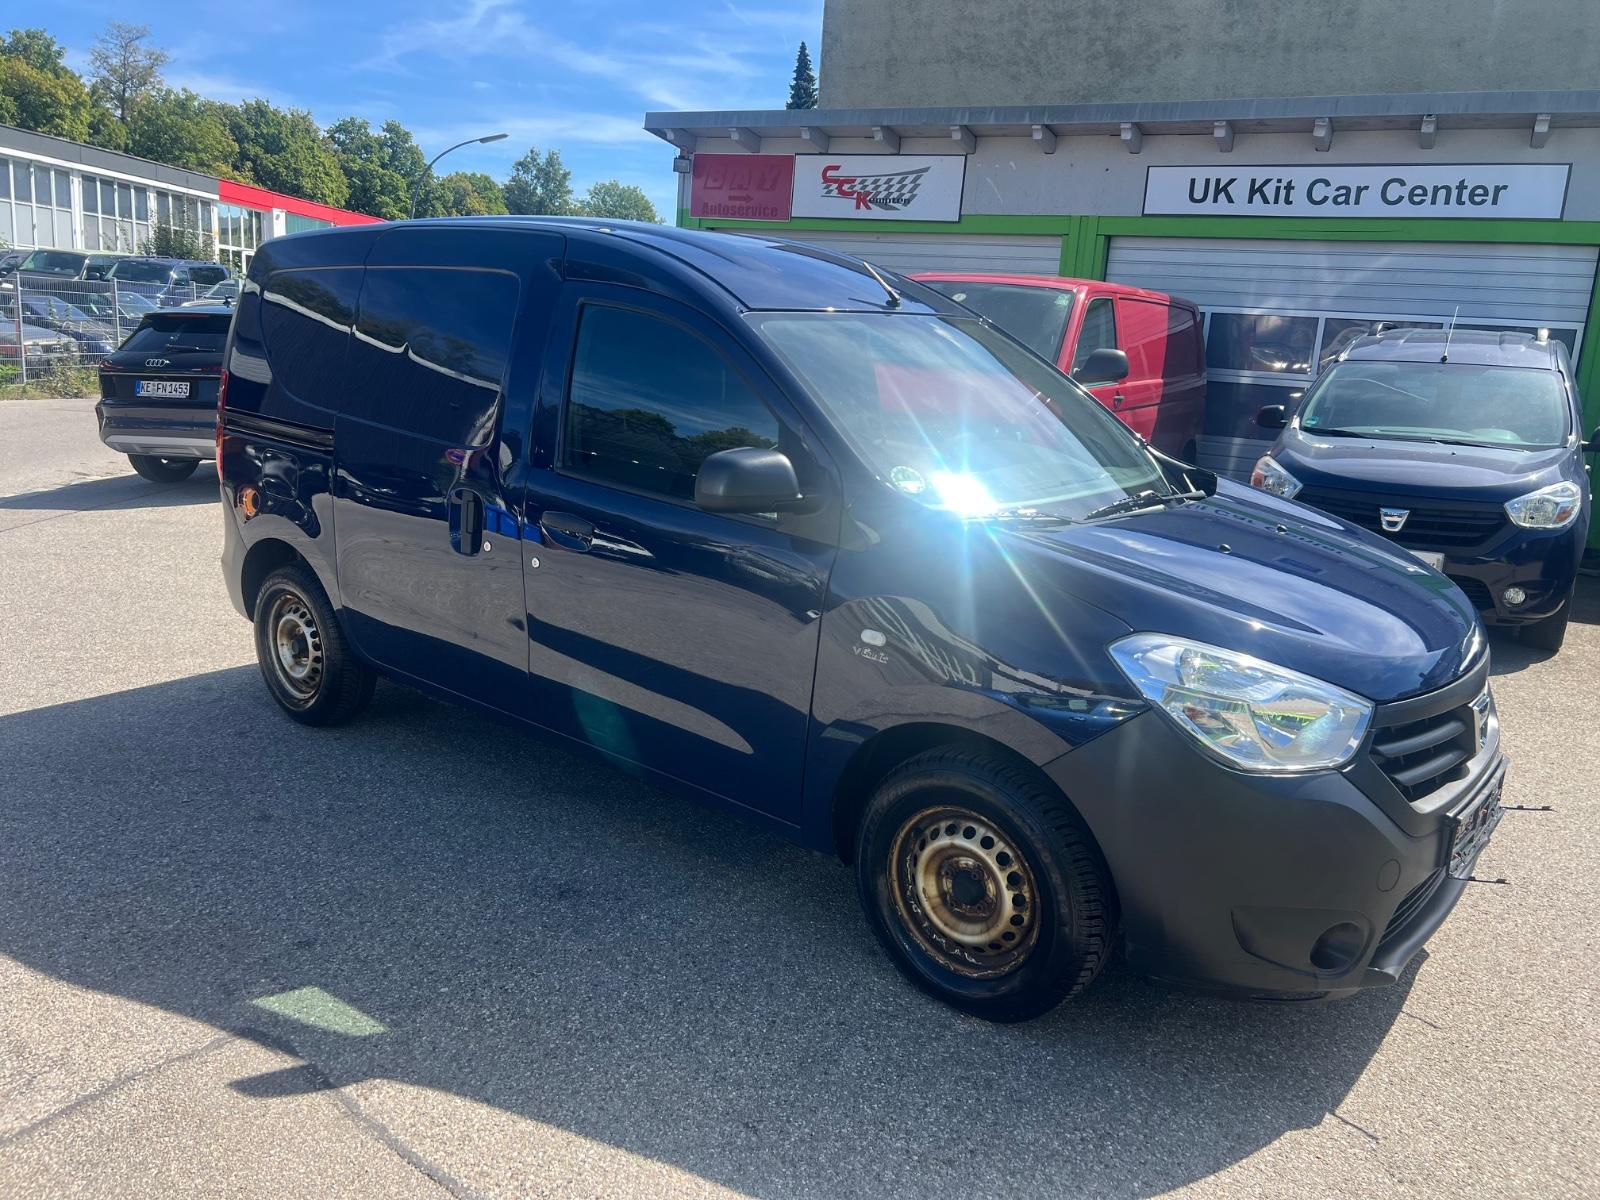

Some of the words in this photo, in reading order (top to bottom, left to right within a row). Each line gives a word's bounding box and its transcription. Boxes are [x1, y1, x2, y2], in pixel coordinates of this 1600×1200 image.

[1188, 177, 1238, 204] UK
[1247, 178, 1295, 205] Kit
[1306, 178, 1369, 206] Car
[1380, 177, 1509, 206] Center
[702, 202, 779, 217] Autoservice
[140, 382, 151, 393] KE
